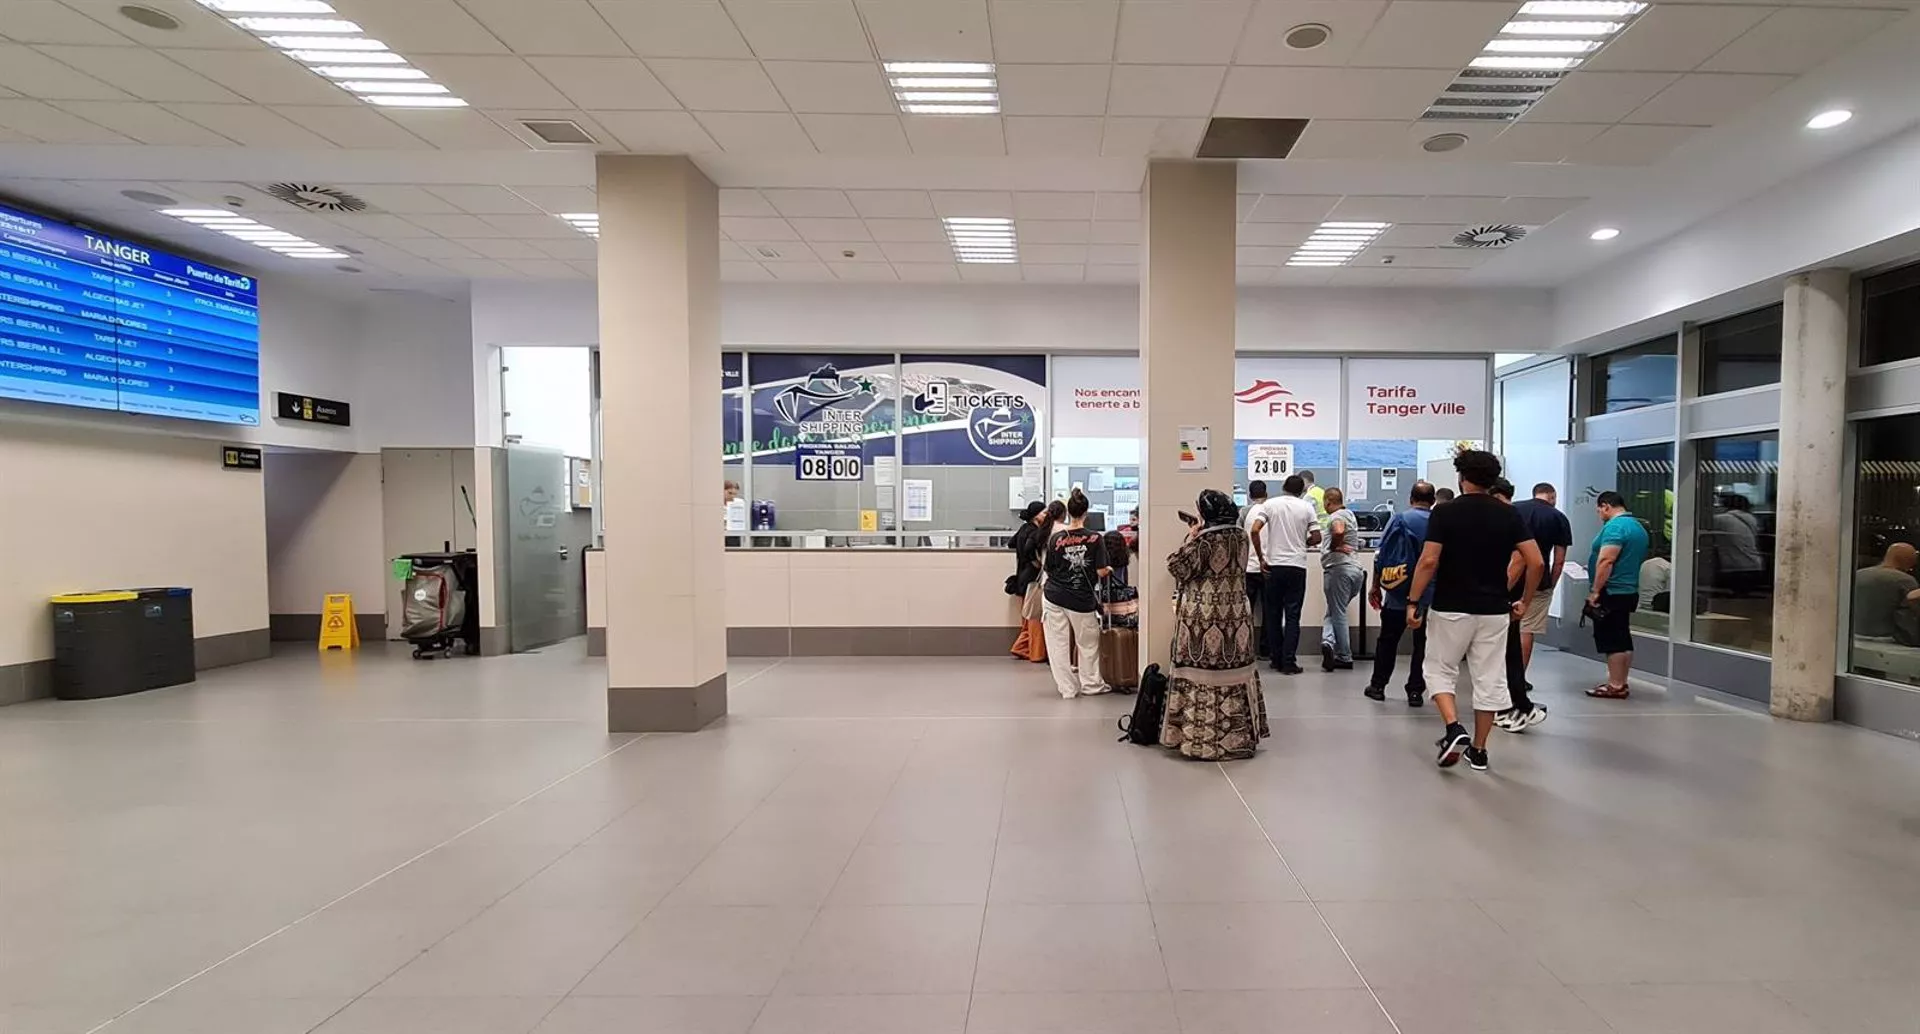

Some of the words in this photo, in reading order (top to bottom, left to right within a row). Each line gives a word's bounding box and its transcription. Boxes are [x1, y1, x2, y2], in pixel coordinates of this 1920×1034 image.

[84, 234, 151, 265] TANGER
[186, 265, 214, 281] Puerto
[214, 273, 224, 284] de
[222, 276, 245, 290] Tarifa
[16, 318, 47, 331] IBERIA
[17, 341, 48, 352] IBERIA
[83, 372, 110, 383] MARIA
[111, 376, 149, 389] DOLORES
[1075, 388, 1098, 397] Nos
[1366, 385, 1417, 398] Tarifa
[953, 395, 1024, 408] TICKETS
[1075, 400, 1121, 408] tenerte
[823, 409, 863, 421] INTER
[1269, 402, 1316, 417] FRS
[1366, 402, 1427, 417] Tanger
[1430, 402, 1466, 414] Ville
[800, 421, 863, 433] SHIPPING
[988, 438, 1024, 446] SHIPPING
[1254, 460, 1287, 474] 23:00
[1381, 563, 1408, 580] NIKE
